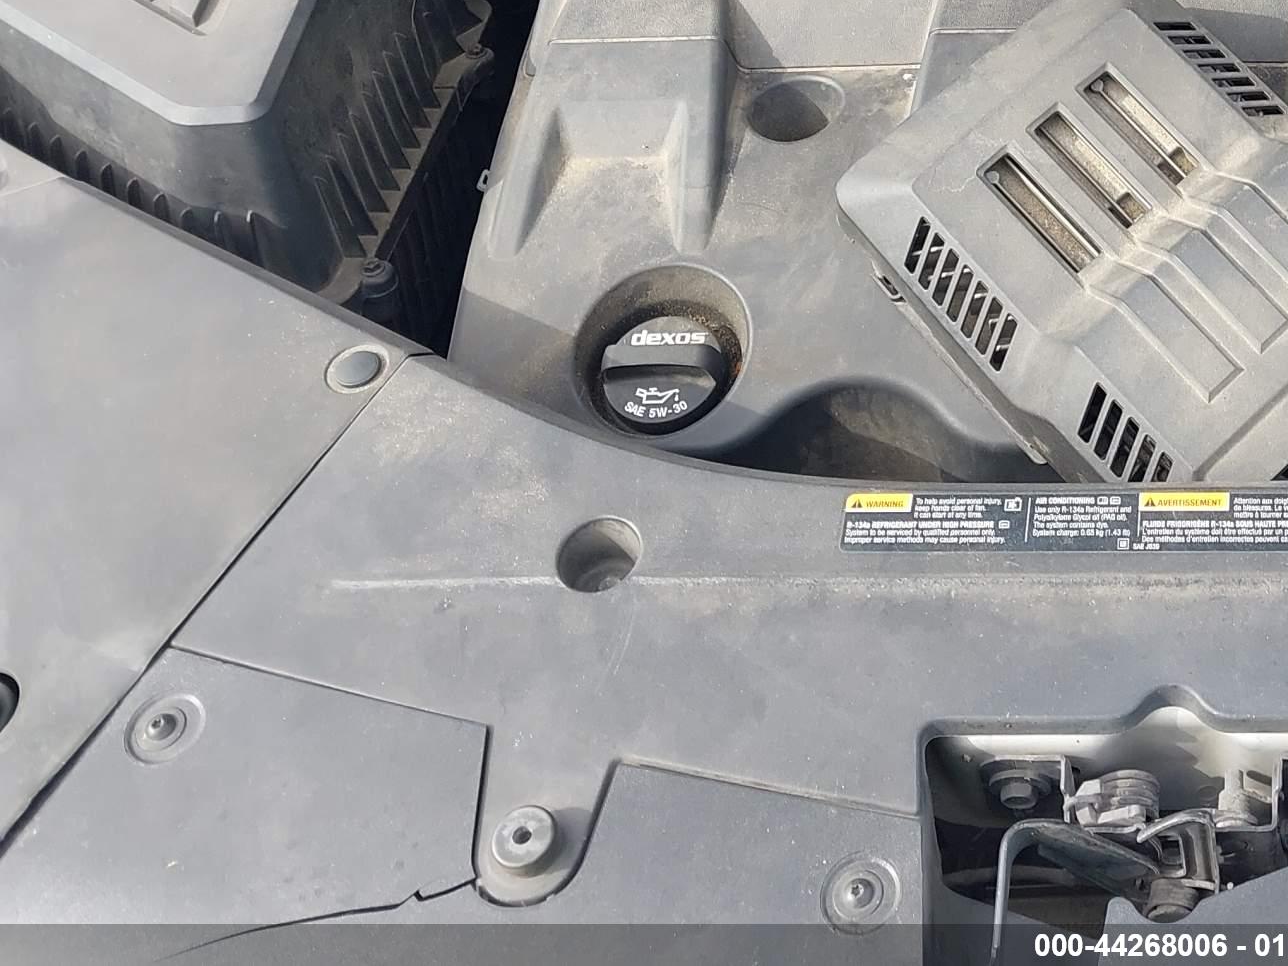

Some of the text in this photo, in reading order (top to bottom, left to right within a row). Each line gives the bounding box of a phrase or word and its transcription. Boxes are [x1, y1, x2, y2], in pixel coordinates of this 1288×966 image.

[631, 330, 706, 345] dexos
[624, 400, 688, 418] SAE 5W-30
[866, 500, 903, 508] WARNING
[1157, 499, 1222, 507] AVERTISSEMENT
